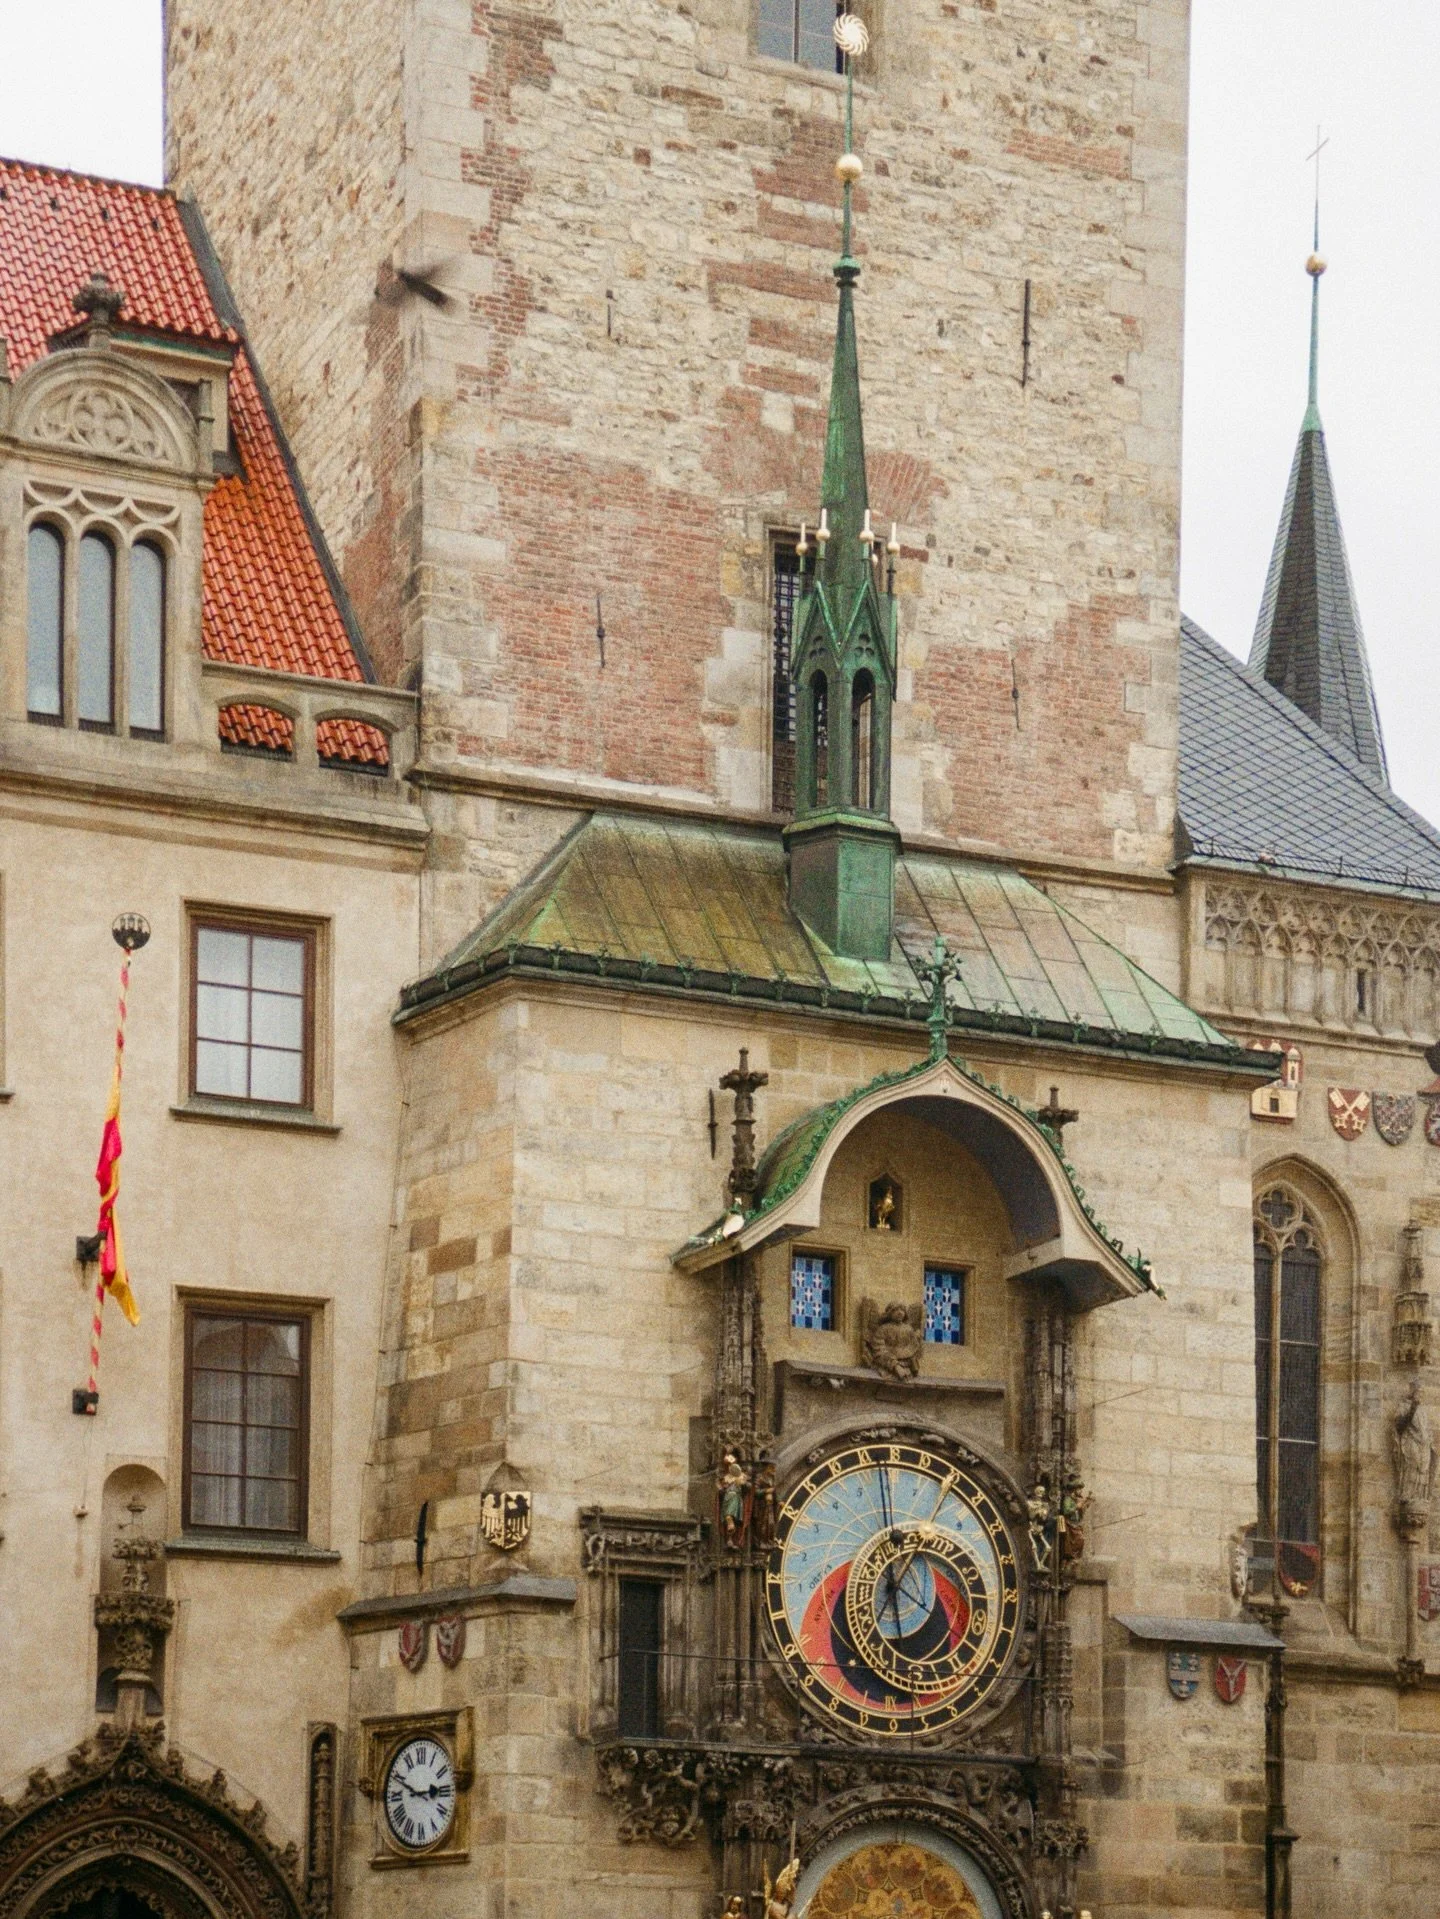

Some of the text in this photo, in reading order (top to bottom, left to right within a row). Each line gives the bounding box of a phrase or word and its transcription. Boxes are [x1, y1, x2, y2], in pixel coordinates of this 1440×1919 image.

[802, 1552, 808, 1562] 2
[404, 1753, 414, 1771] XI
[416, 1746, 426, 1765] XII
[436, 1765, 448, 1779] II
[390, 1791, 402, 1802] IX
[438, 1785, 451, 1797] III
[393, 1803, 407, 1827] VIII
[404, 1818, 414, 1838] VII
[418, 1823, 425, 1841] VI
